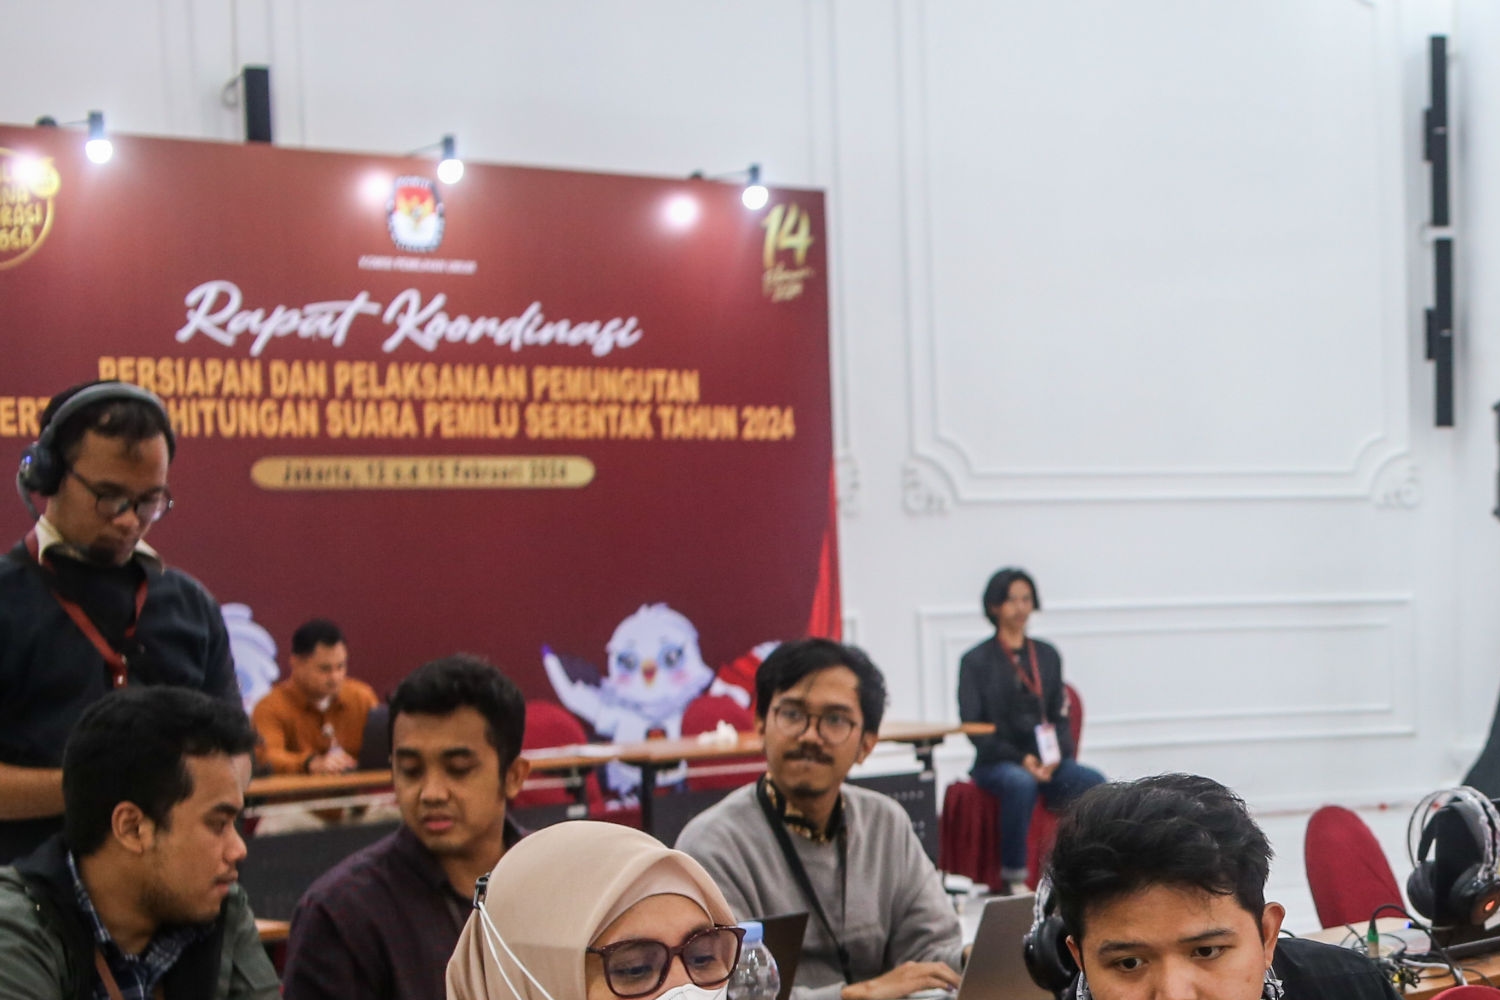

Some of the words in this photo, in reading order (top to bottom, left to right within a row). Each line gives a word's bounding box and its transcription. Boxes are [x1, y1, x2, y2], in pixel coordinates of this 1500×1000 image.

[761, 202, 814, 268] 14
[175, 280, 382, 356] Rapat
[382, 288, 643, 357] Koordinasi
[99, 356, 263, 397] PERSIAPAN
[270, 360, 328, 398] DAN
[334, 360, 527, 400] PELAKSANAAN
[532, 365, 700, 403] PEMUNGUTAN
[168, 397, 320, 438] HITUNGAN
[326, 400, 419, 439] SUARA
[423, 401, 520, 440] PEMILU
[524, 402, 654, 440] SERENTAK
[657, 403, 739, 440] TAHUN
[741, 404, 796, 441] 2024
